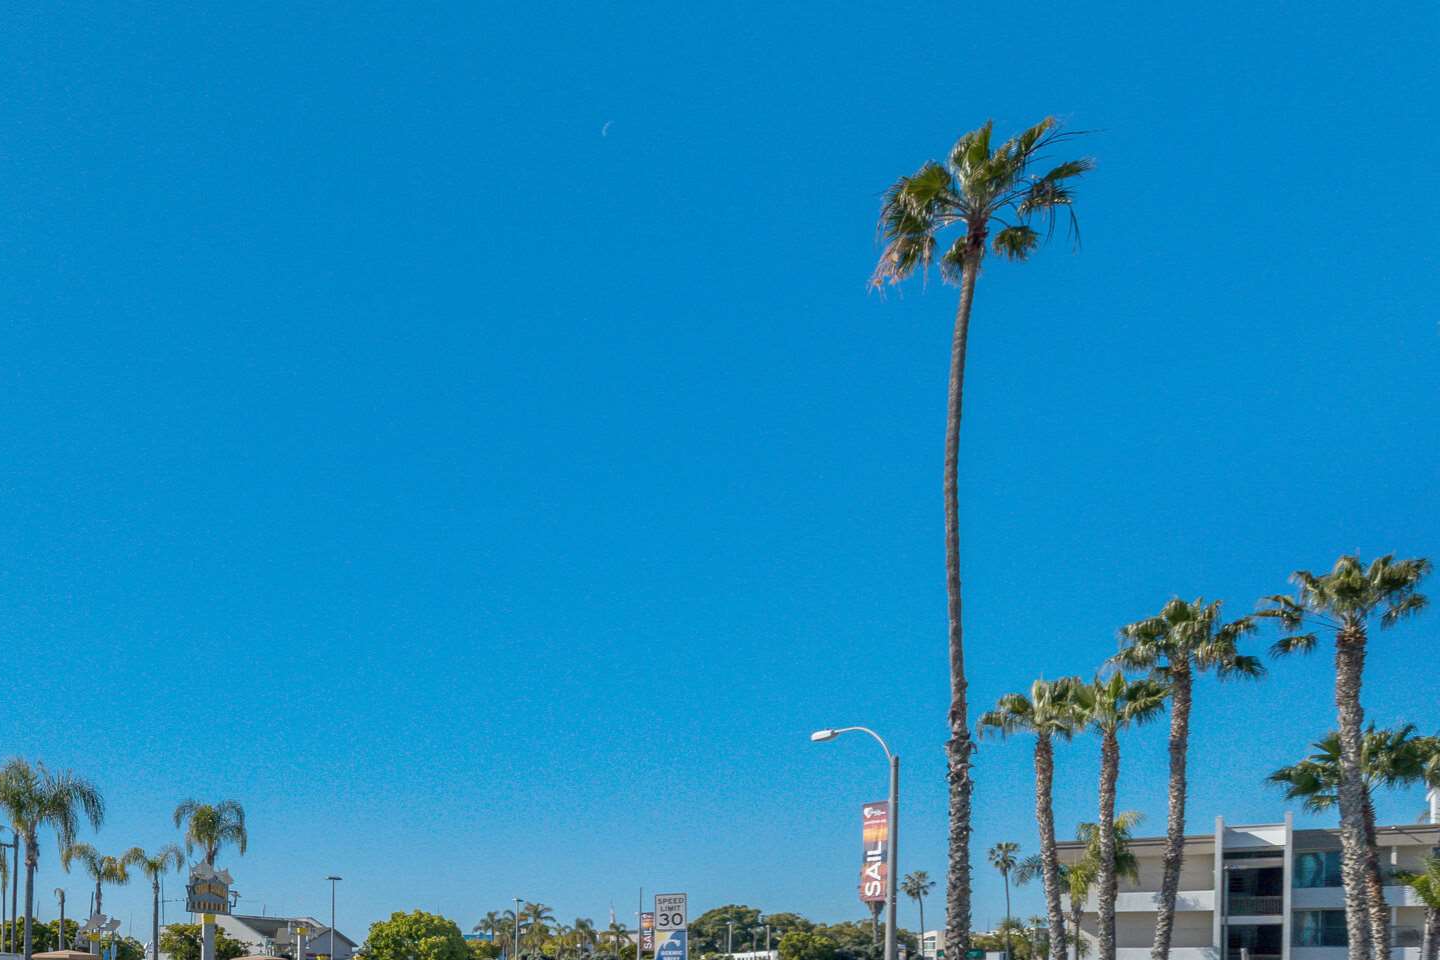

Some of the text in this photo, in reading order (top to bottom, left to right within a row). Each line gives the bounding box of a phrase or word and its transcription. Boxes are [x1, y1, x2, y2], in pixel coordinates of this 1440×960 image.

[865, 840, 882, 896] SAIL
[659, 912, 684, 926] 30
[644, 928, 653, 949] SAIL
